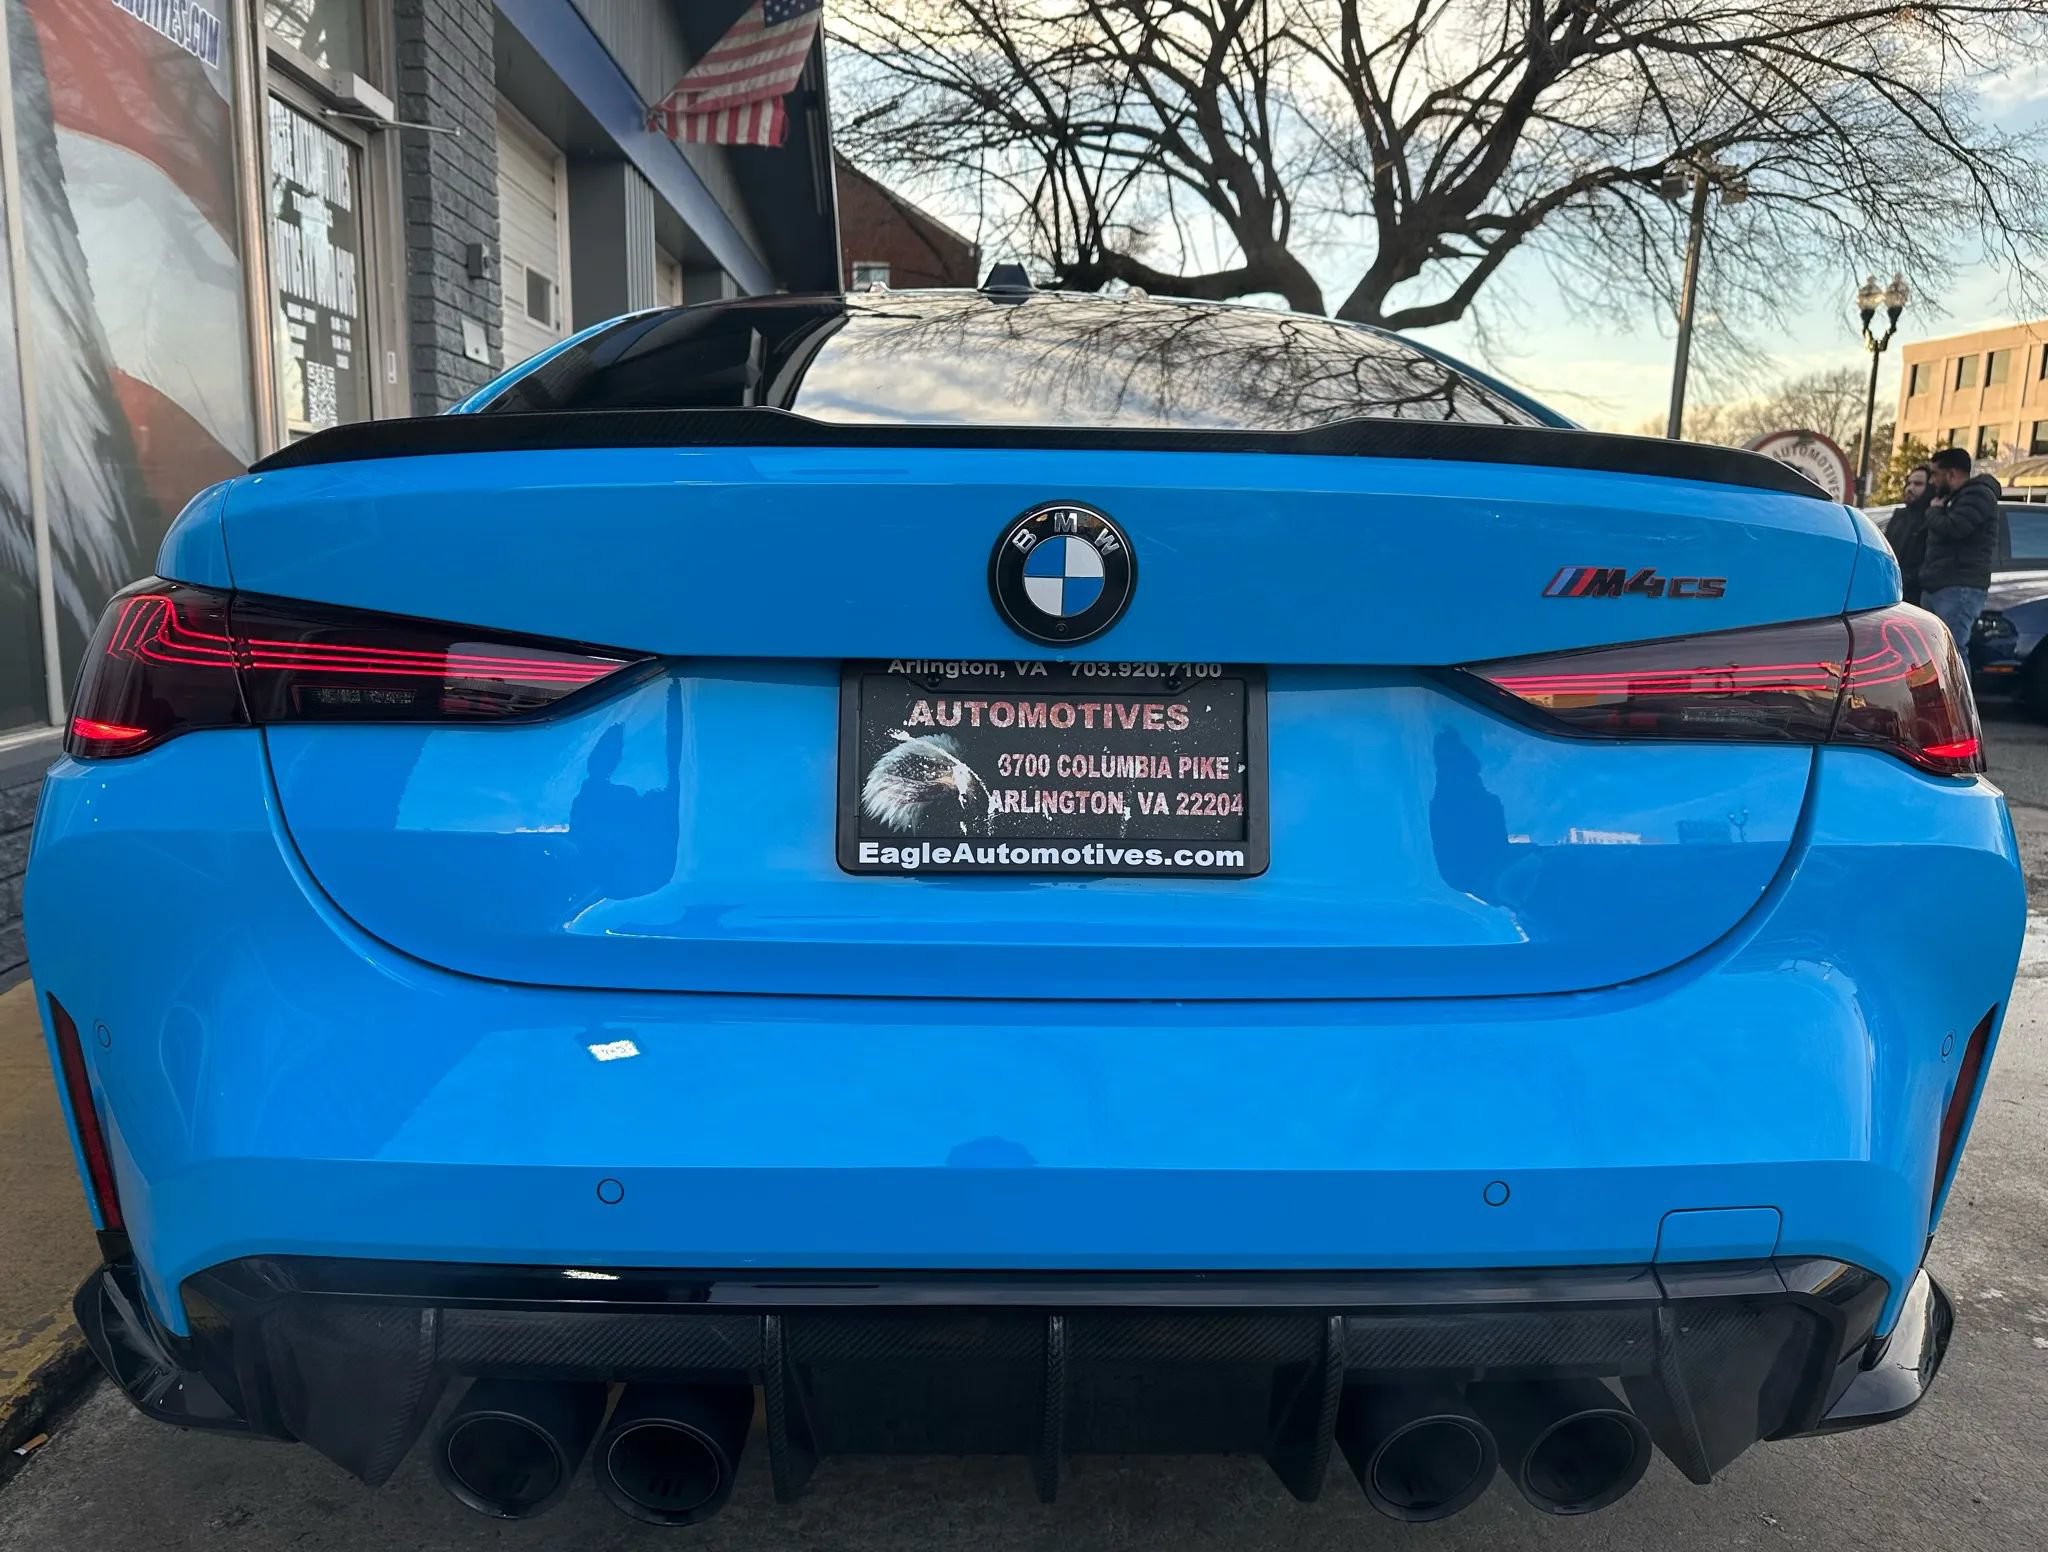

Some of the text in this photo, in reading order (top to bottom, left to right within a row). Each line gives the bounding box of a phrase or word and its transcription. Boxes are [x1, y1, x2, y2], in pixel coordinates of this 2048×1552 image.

[1012, 512, 1120, 556] BMW
[888, 660, 1222, 678] Arlington, VA 703.920.7100
[908, 699, 1190, 731] AUTOMOTIVES
[998, 753, 1230, 780] 3700 COLUMBIA PIKE
[1137, 791, 1170, 816] VA
[1175, 792, 1244, 817] 22204
[858, 842, 1244, 869] EagleAutomotives.com
